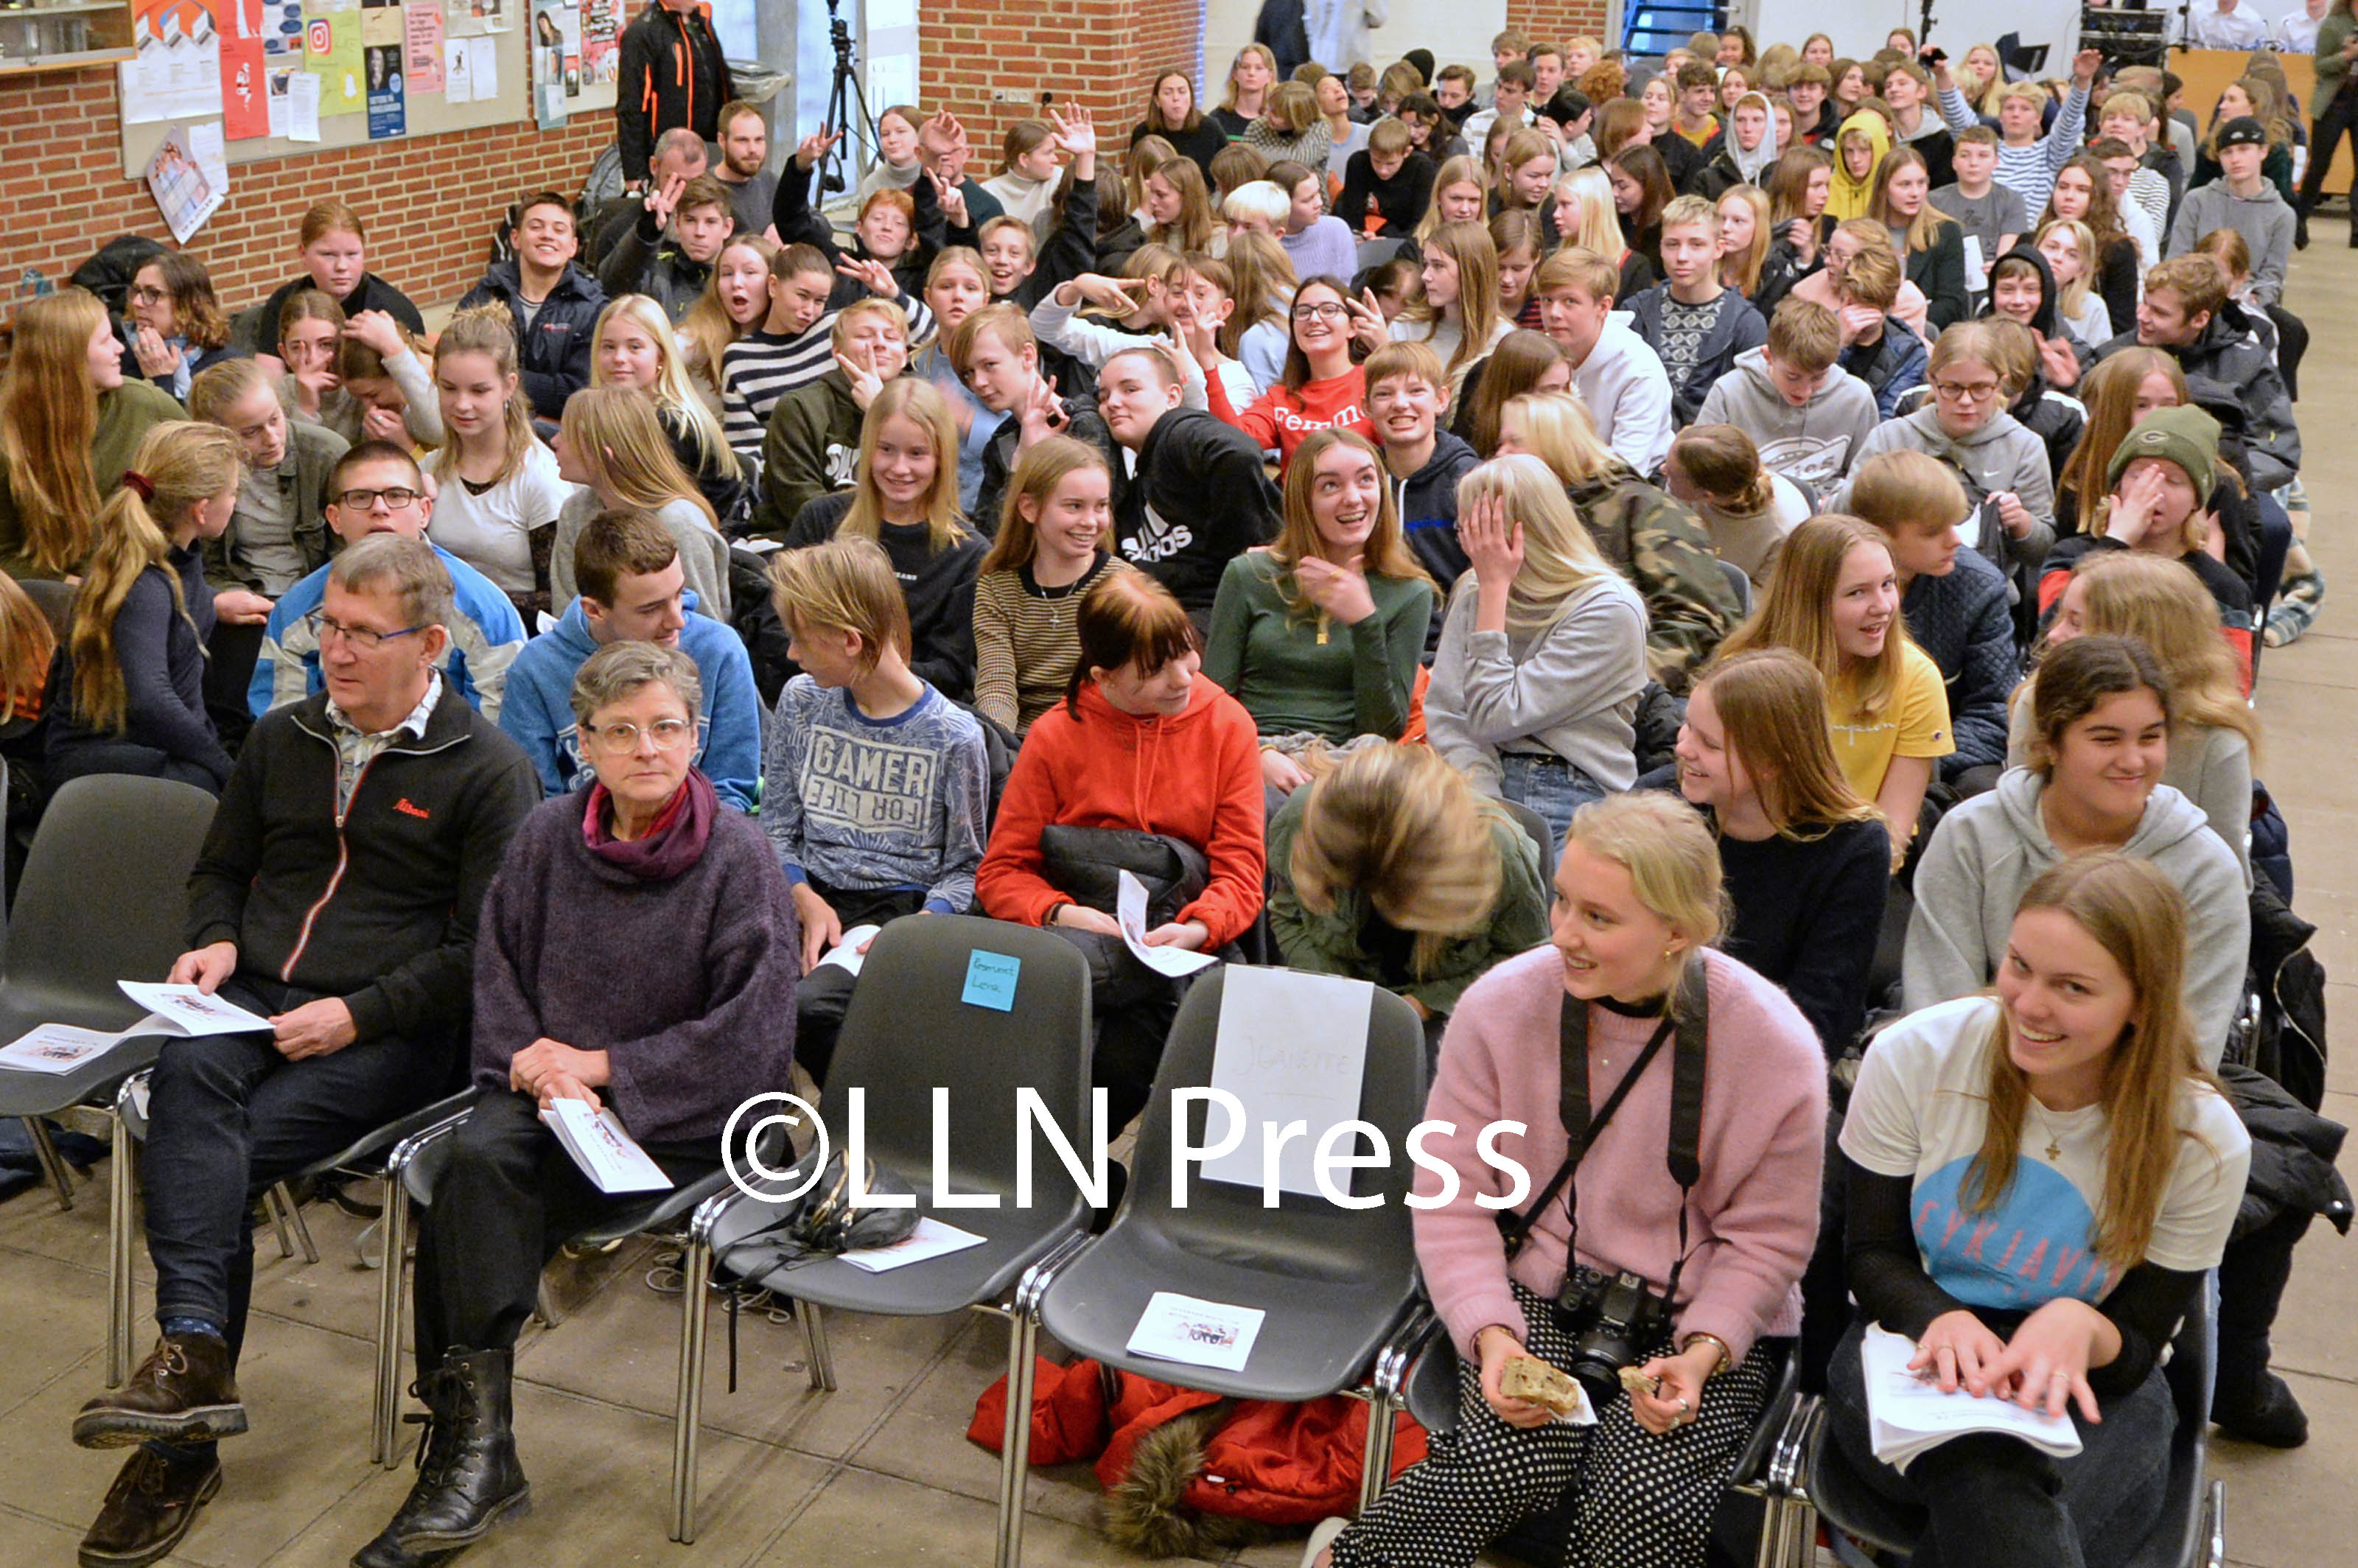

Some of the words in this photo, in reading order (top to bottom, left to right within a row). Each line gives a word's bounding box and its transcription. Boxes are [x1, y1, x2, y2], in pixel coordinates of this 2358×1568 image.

[1273, 405, 1365, 431] Femm
[813, 735, 928, 797] GAMER
[808, 778, 862, 819] LIFE
[871, 795, 919, 825] FOR
[1916, 1199, 2124, 1298] EYKJAVI
